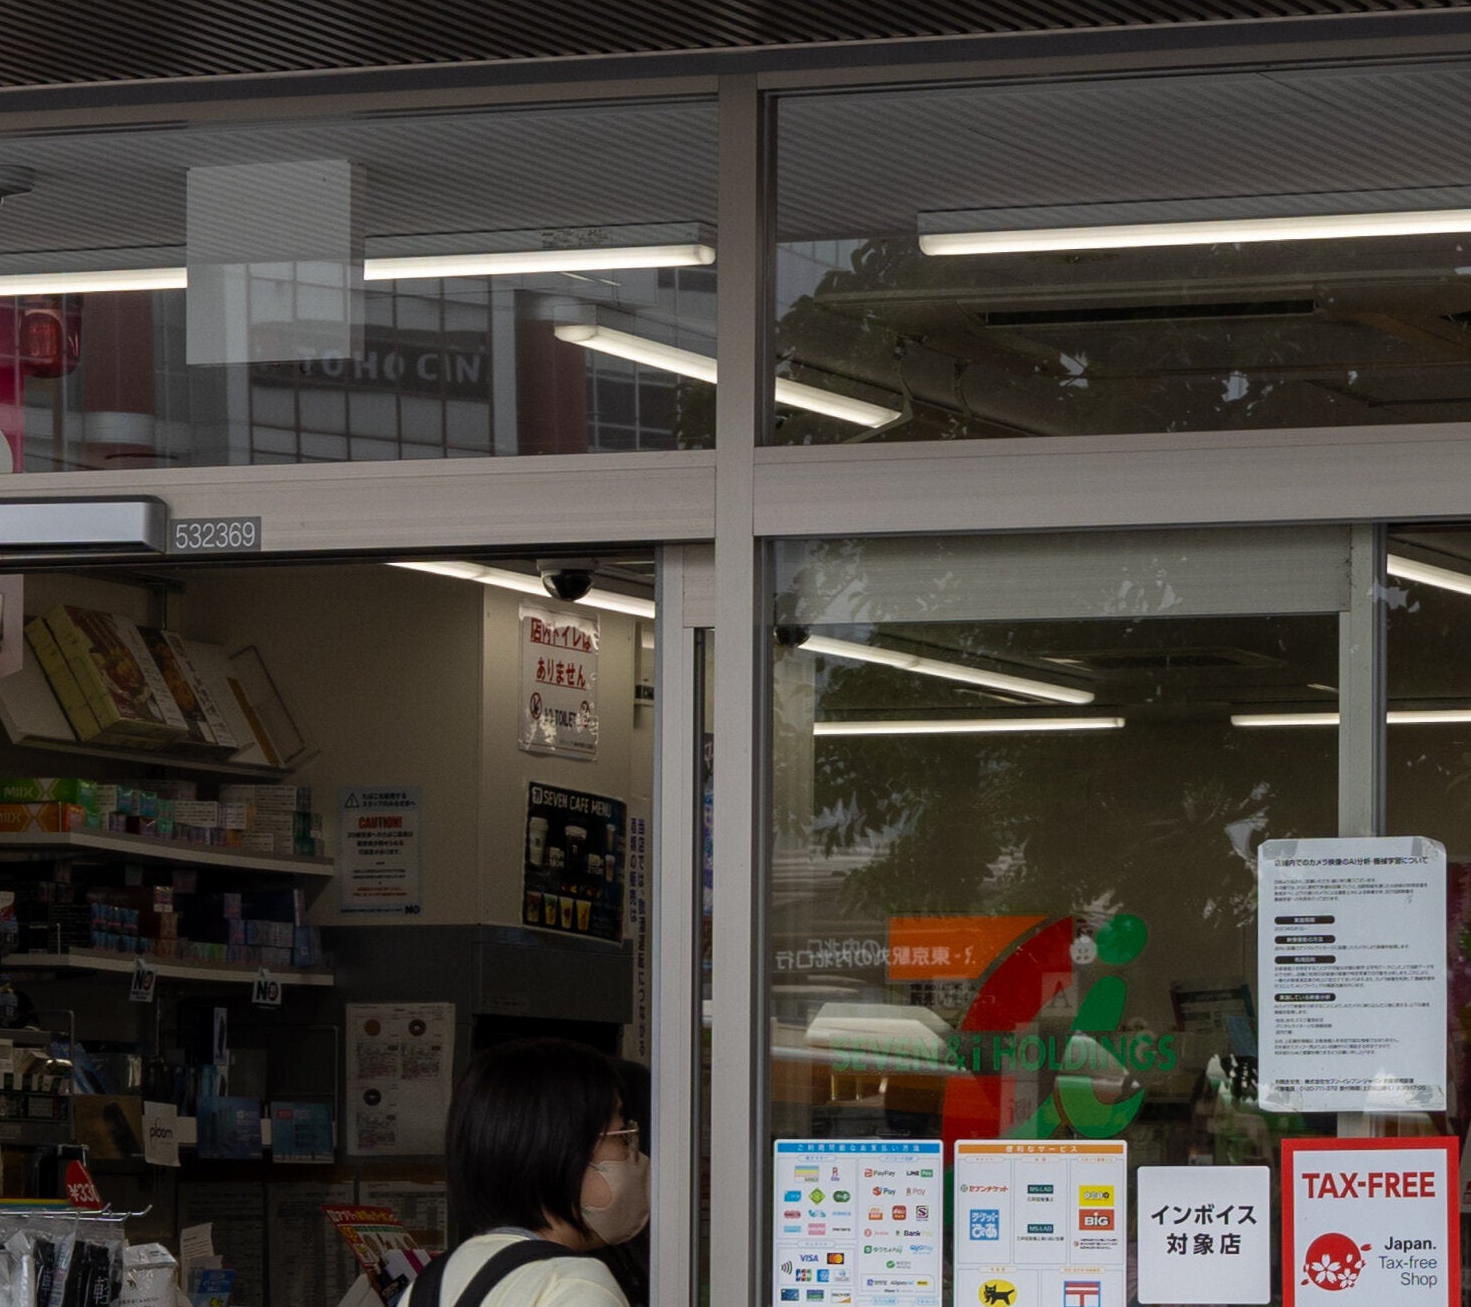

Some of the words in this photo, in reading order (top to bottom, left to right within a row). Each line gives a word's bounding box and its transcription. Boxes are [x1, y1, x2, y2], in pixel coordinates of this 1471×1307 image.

[175, 521, 256, 549] 532369
[536, 657, 587, 688] ありません
[544, 791, 567, 810] SEVEN
[359, 816, 402, 829] CAUTION!
[993, 1033, 1176, 1073] HOLDINGS
[1006, 1144, 1078, 1153] 便利なサービス
[873, 1169, 896, 1178] PayPay
[969, 1184, 1008, 1193] セブンチケット
[1301, 1171, 1436, 1199] TAX-FREE
[1151, 1203, 1257, 1226] インボイス
[972, 1222, 998, 1239] ぴあ
[1166, 1232, 1242, 1255] 対象店
[1384, 1236, 1437, 1253] Japan.
[800, 1254, 819, 1263] VISA
[1378, 1255, 1437, 1270] Tax-free
[1400, 1272, 1438, 1290] Shop
